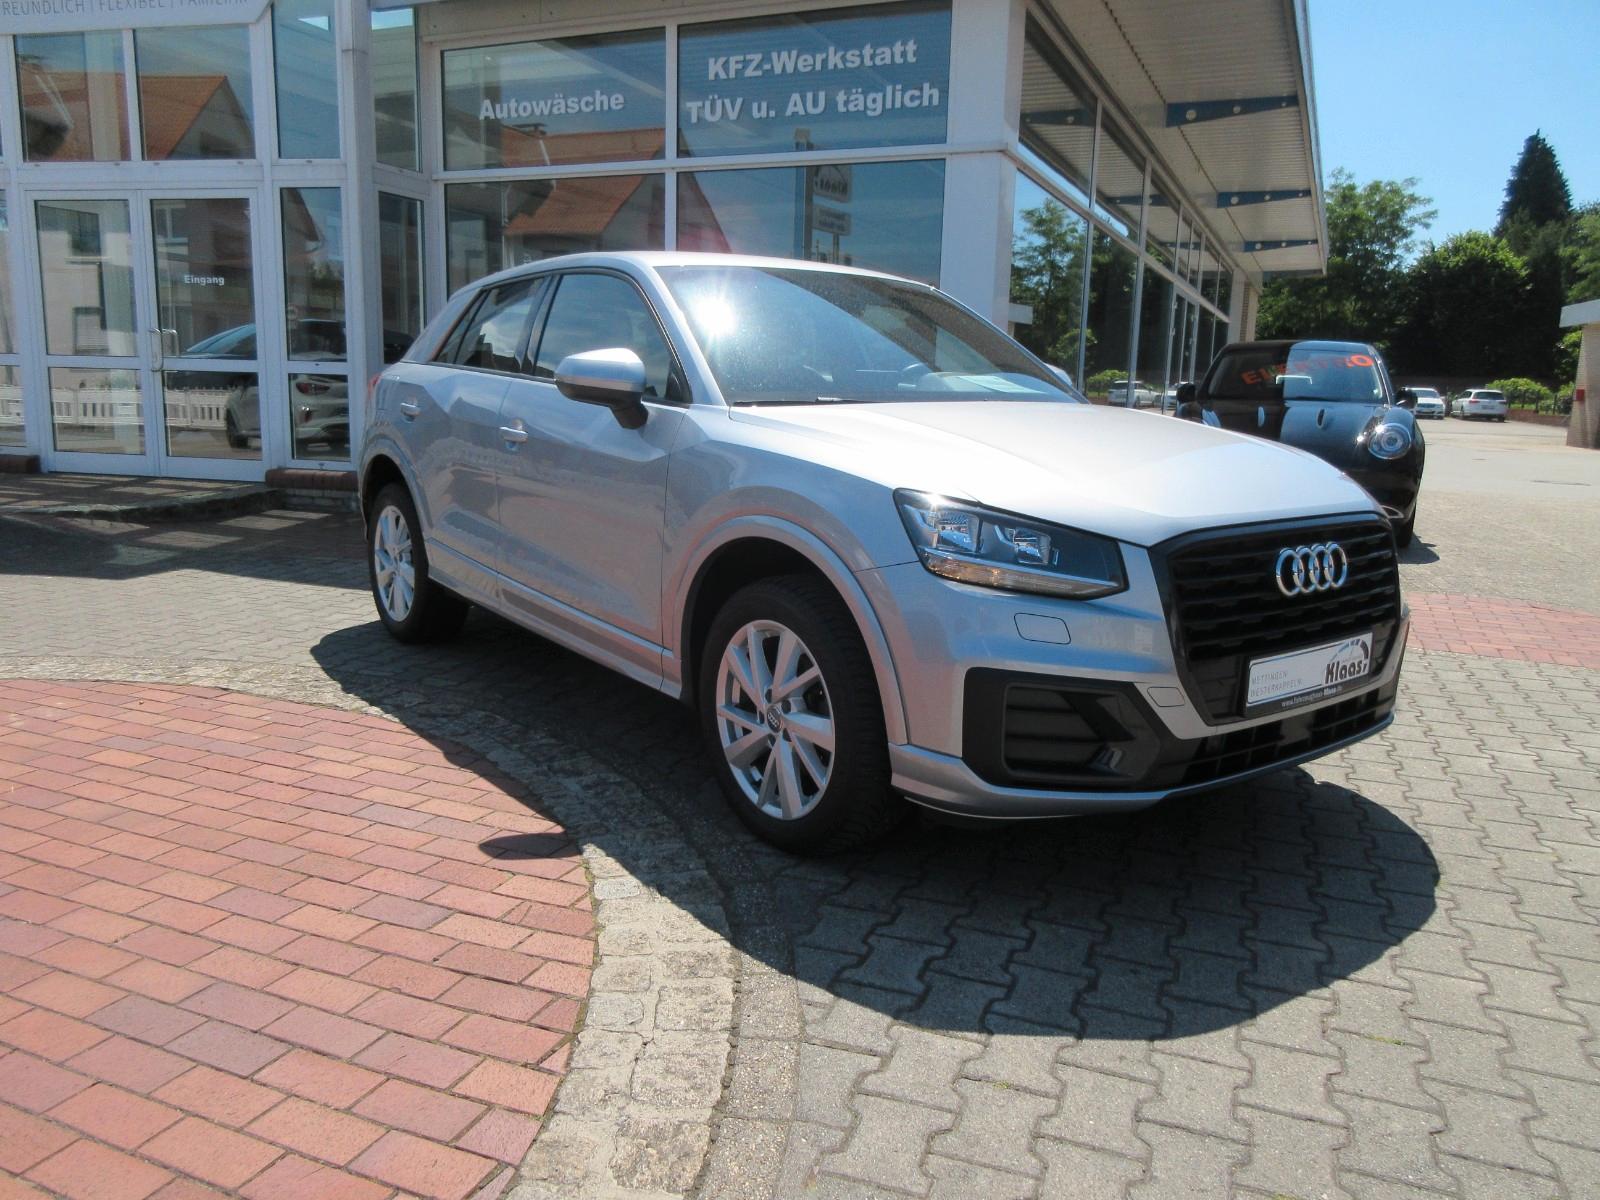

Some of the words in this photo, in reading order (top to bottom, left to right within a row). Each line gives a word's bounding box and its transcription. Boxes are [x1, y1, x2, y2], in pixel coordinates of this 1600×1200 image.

[708, 38, 918, 81] KFZ-Werkstatt
[479, 90, 625, 121] Autowäsche
[686, 94, 744, 124] TÜV
[752, 102, 776, 119] u.
[785, 91, 826, 117] AU
[836, 82, 940, 117] täglich
[184, 275, 225, 286] Eingang
[1325, 659, 1363, 685] Klaas
